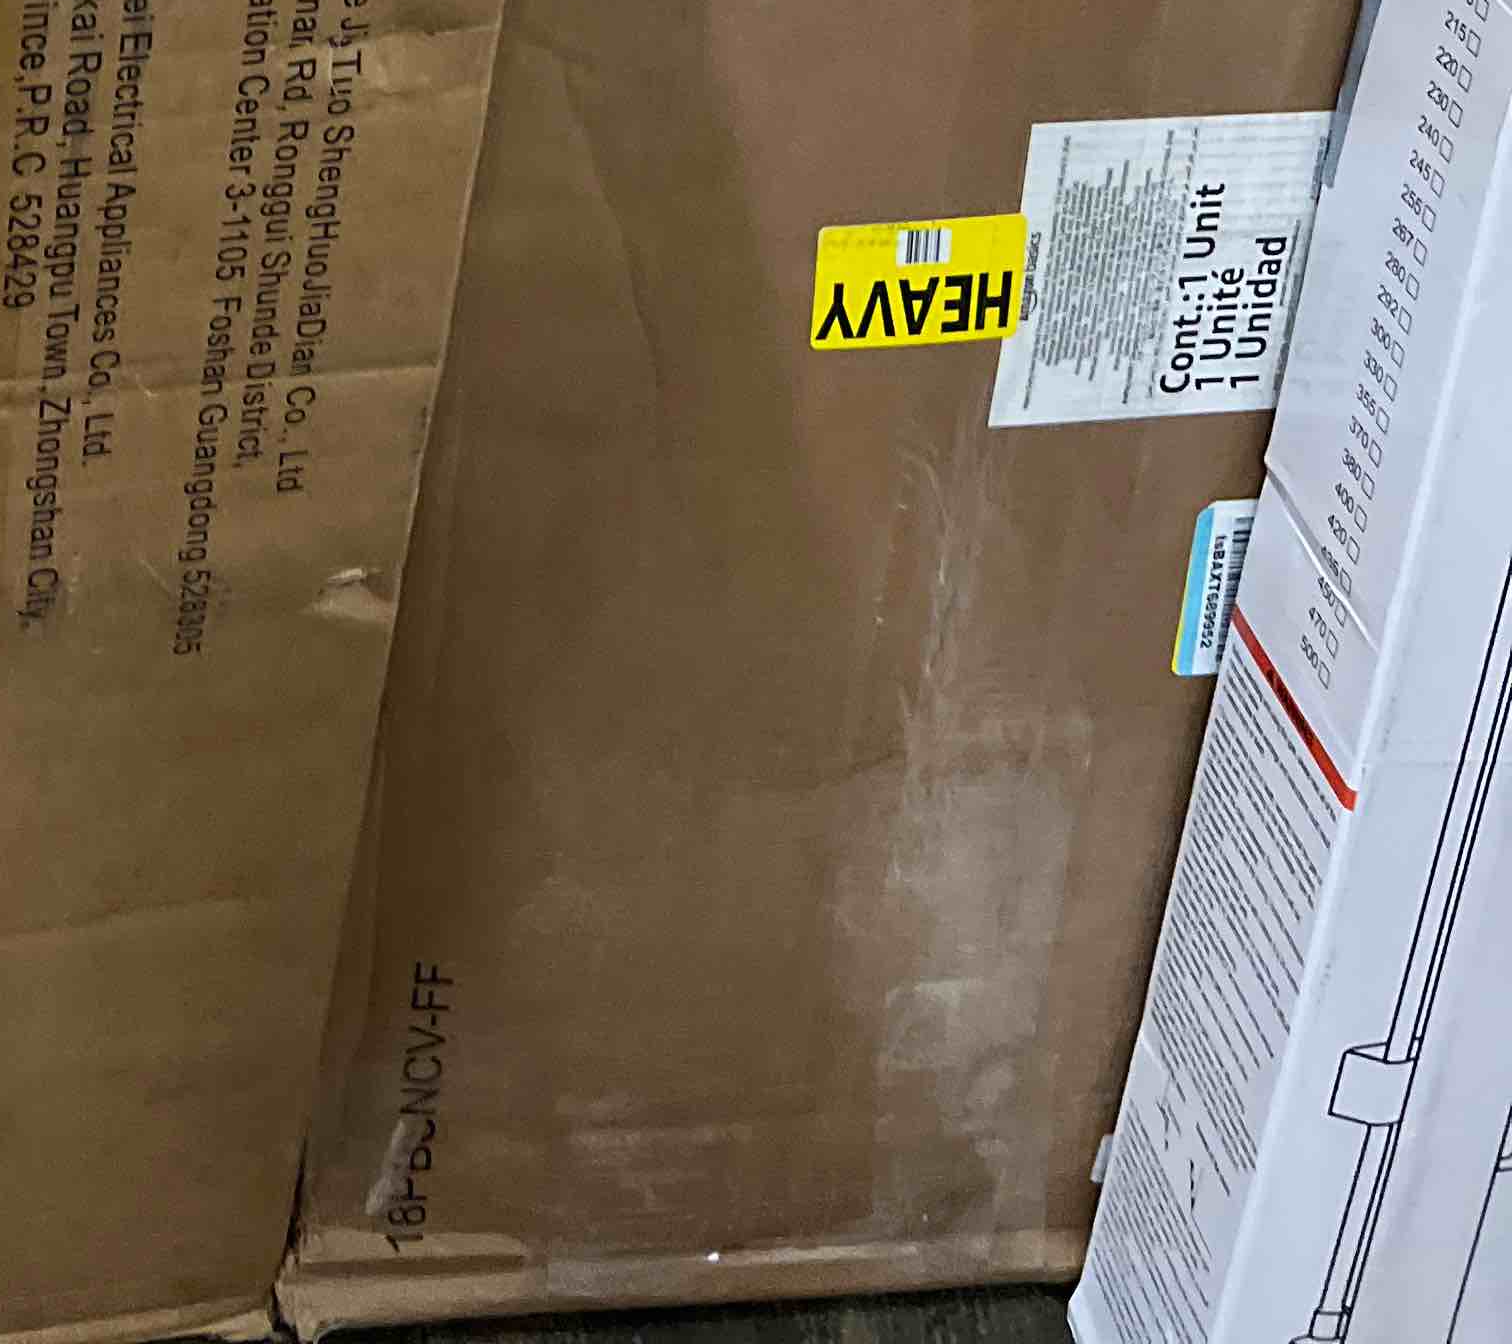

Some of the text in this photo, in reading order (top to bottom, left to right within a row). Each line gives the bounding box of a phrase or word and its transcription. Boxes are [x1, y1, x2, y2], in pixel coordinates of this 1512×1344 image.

[1435, 46, 1459, 76] 220
[55, 51, 104, 149] Road,
[107, 31, 153, 175] Electrical
[227, 75, 270, 175] Center
[1416, 115, 1441, 146] 240
[44, 157, 93, 298] Huangpu
[214, 183, 257, 281] 3-1105
[1182, 183, 1226, 259] Unit
[1401, 183, 1424, 215] 255
[3, 193, 43, 310] 528429
[91, 182, 137, 344] Appliances
[291, 124, 357, 377] ShengHuoJiaDian
[1385, 251, 1408, 282] 280
[232, 121, 309, 469] Ronggui Shunde District,
[815, 270, 1014, 342] HEAVY
[1194, 268, 1244, 391] 1 Unité
[1230, 236, 1287, 388] 1 Unidad
[1370, 317, 1393, 349] 300
[81, 350, 121, 406] Co.,
[200, 296, 242, 396] Foshan
[277, 386, 316, 443] Co.,
[1355, 384, 1378, 415] 355
[81, 413, 114, 468] Ltd.
[276, 450, 309, 494] Ltd
[1341, 447, 1363, 479] 380
[26, 398, 71, 561] Zhongshan
[178, 405, 228, 561] Guangdong
[1326, 513, 1349, 545] 420
[1299, 636, 1320, 666] 500
